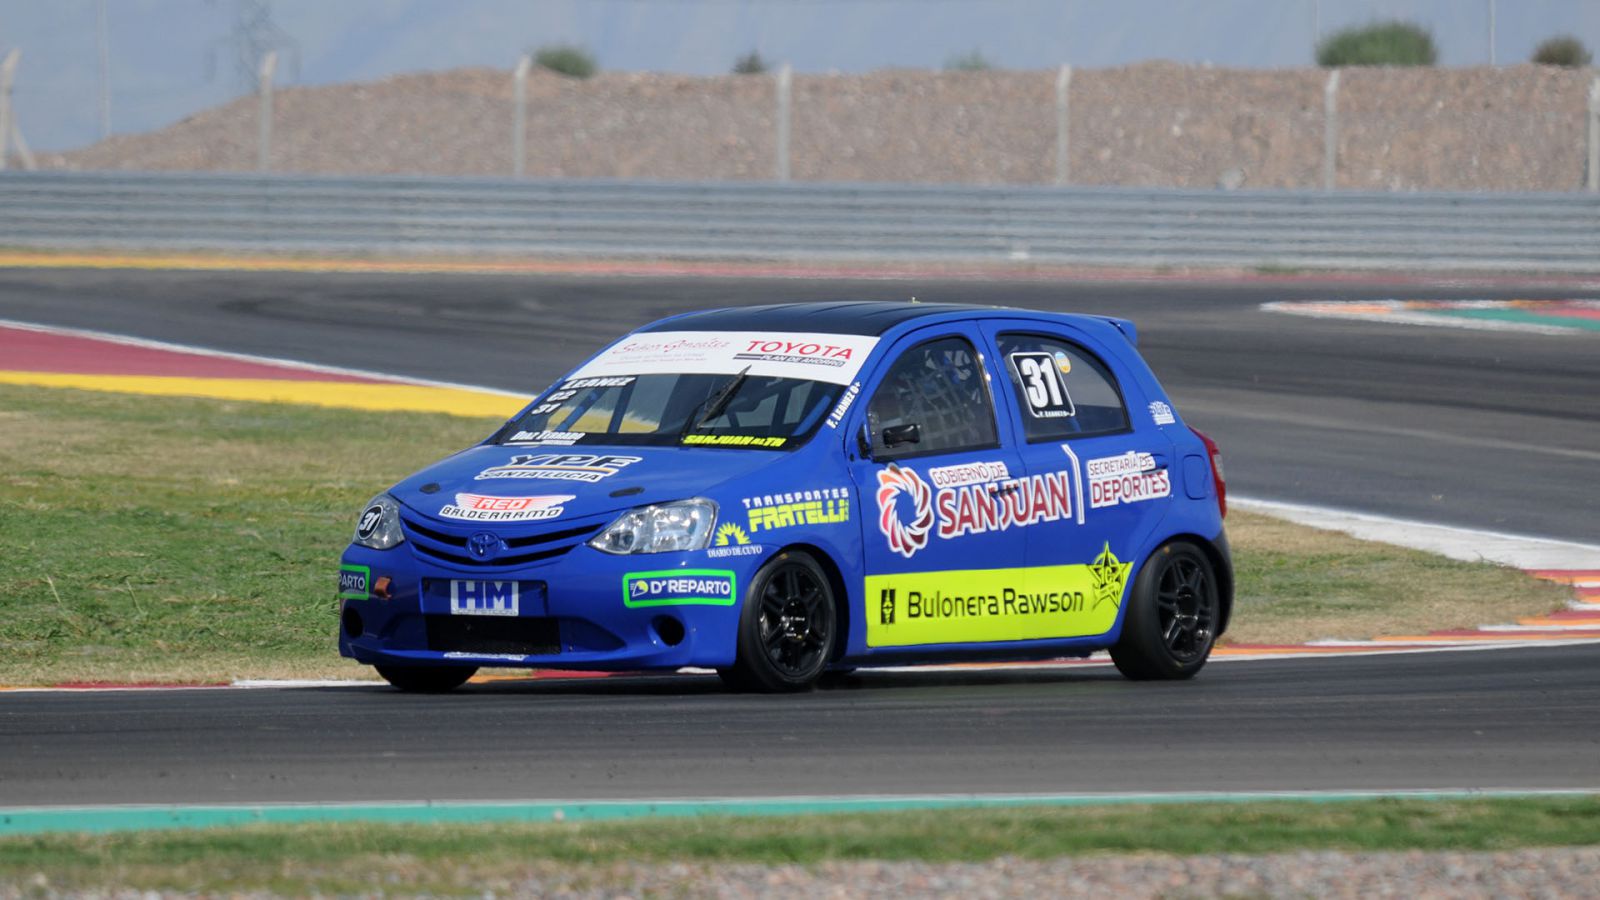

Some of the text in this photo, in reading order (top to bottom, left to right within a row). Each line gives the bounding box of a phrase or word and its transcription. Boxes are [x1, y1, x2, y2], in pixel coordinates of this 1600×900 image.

[746, 341, 853, 360] TOYOTA
[761, 354, 786, 362] PLAN
[1021, 358, 1063, 408] 31
[531, 403, 561, 414] 31
[511, 455, 640, 467] YPF
[480, 471, 537, 479] SANTA
[931, 463, 1006, 485] GOBIERNO DE
[1092, 472, 1168, 504] DEPORTES
[476, 498, 528, 510] RED
[743, 488, 849, 508] TRANSPORTES
[360, 512, 380, 530] 31
[441, 507, 561, 519] BALDERRAMO
[748, 499, 845, 532] FRATELLI
[707, 544, 762, 558] DIARIO DE CUYO
[457, 582, 512, 608] HM
